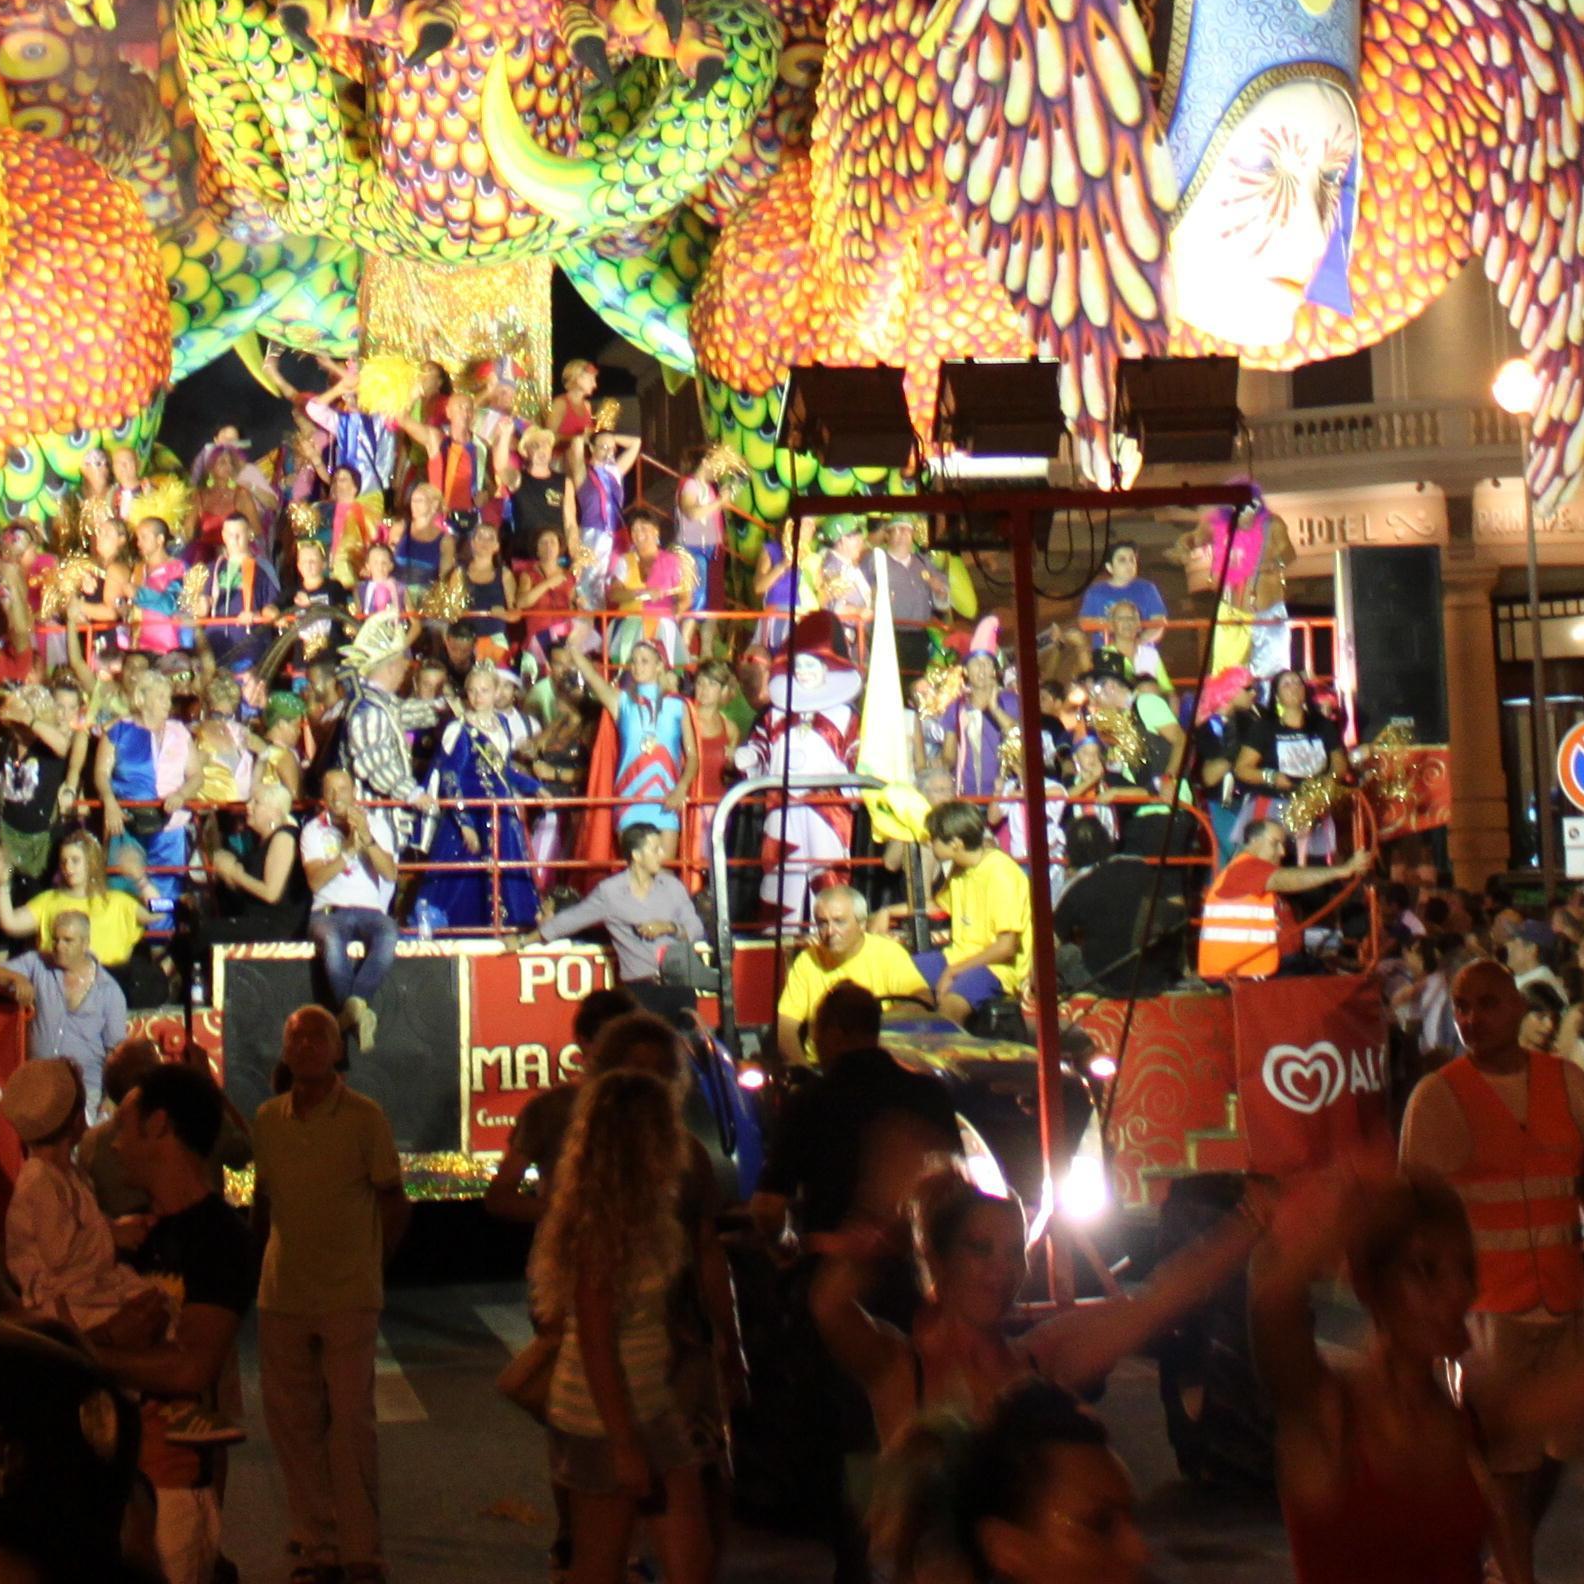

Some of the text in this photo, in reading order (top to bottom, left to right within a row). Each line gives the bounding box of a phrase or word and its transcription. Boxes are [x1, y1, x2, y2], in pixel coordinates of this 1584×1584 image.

[1298, 512, 1377, 546] HOTEL
[1474, 508, 1573, 537] PRINIPE
[471, 1043, 584, 1092] MAS
